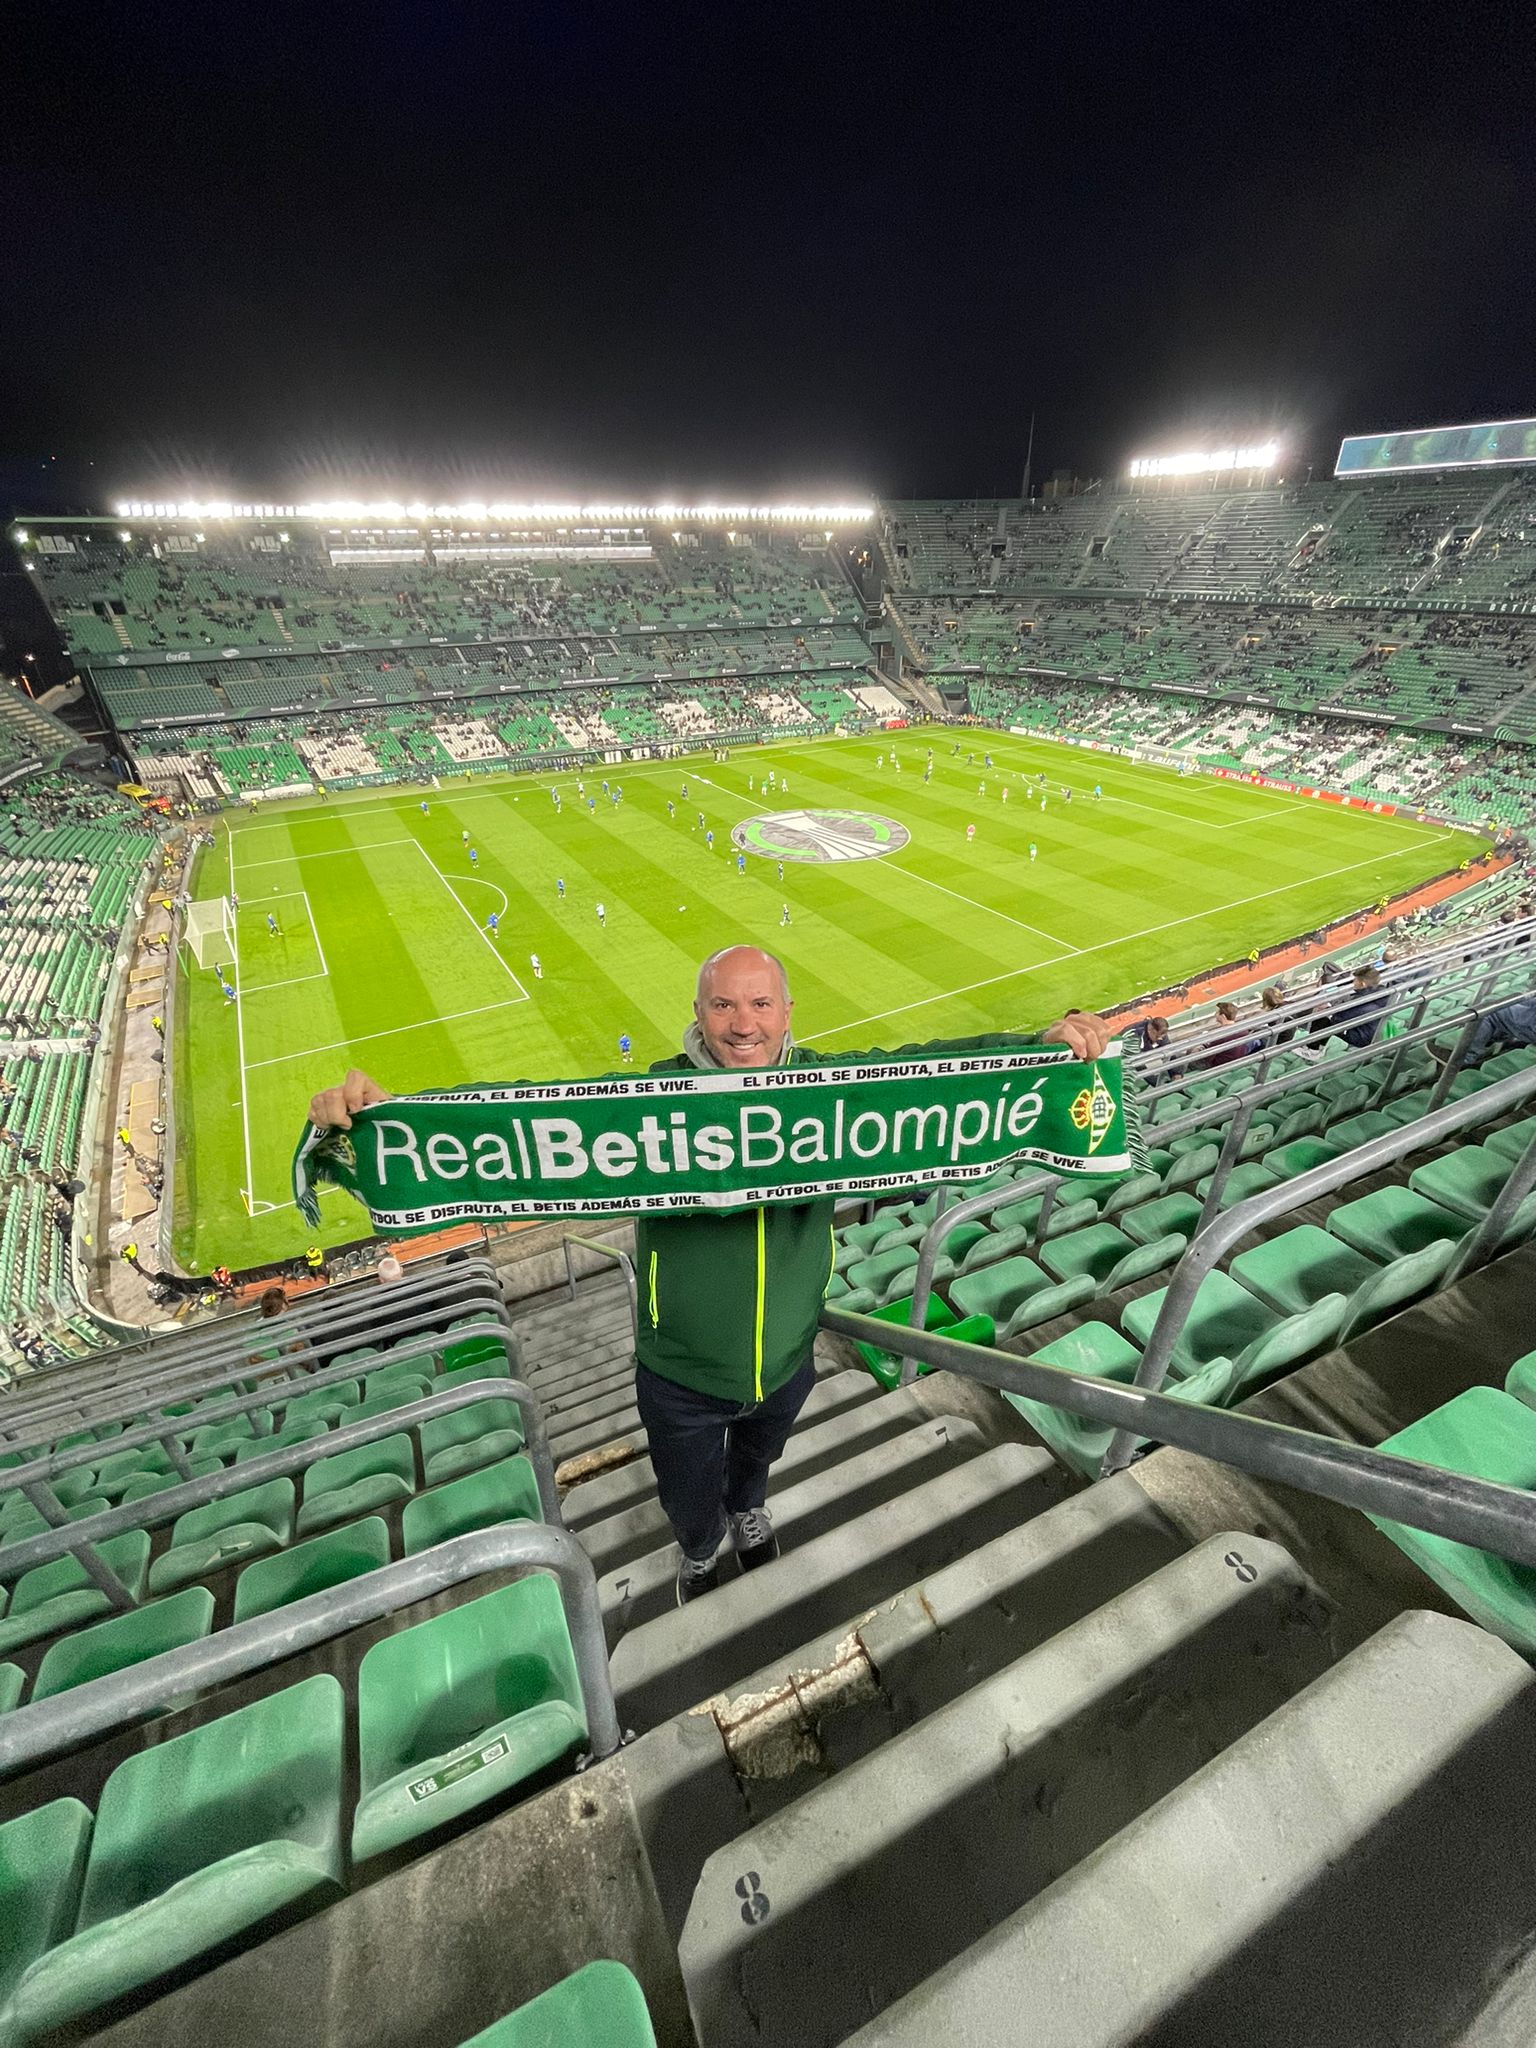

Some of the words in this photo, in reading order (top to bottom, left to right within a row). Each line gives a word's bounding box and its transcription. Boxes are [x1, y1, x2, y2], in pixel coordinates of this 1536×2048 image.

[1364, 599, 1407, 609] mundo
[1488, 602, 1536, 615] BETIS
[743, 1076, 761, 1087] EL
[765, 1072, 826, 1086] FÚTBOL
[832, 1070, 850, 1081] SE
[856, 1064, 933, 1080] DISFRUTA,
[937, 1063, 955, 1073] EL
[960, 1059, 1004, 1071] BETIS
[1007, 1053, 1068, 1068] ADEMÁS
[490, 1091, 509, 1100] EL
[514, 1088, 560, 1099] BETIS
[565, 1081, 629, 1097] ADEMÁS
[635, 1082, 654, 1093] SE
[659, 1080, 698, 1092] VIVE.
[746, 1191, 762, 1201] EL
[766, 1187, 821, 1198] FÚTBOL
[826, 1182, 843, 1191] SE
[849, 1175, 918, 1189] DISFRUTA,
[922, 1171, 938, 1180] EL
[942, 1167, 981, 1178] BETIS
[1031, 1150, 1049, 1161] SE
[1053, 1156, 1087, 1170] VIVE.
[371, 1212, 401, 1225] TBOL
[405, 1211, 425, 1223] SE
[431, 1204, 507, 1220] DISFRUTA,
[511, 1203, 529, 1212] EL
[533, 1201, 576, 1212] BETIS
[581, 1197, 641, 1210] ADEMÁS
[646, 1197, 665, 1207] SE
[669, 1195, 705, 1206] VIVE.
[935, 1426, 949, 1445] 7
[1224, 1551, 1258, 1583] 8
[615, 1577, 632, 1601] 7
[734, 1871, 771, 1926] 8
